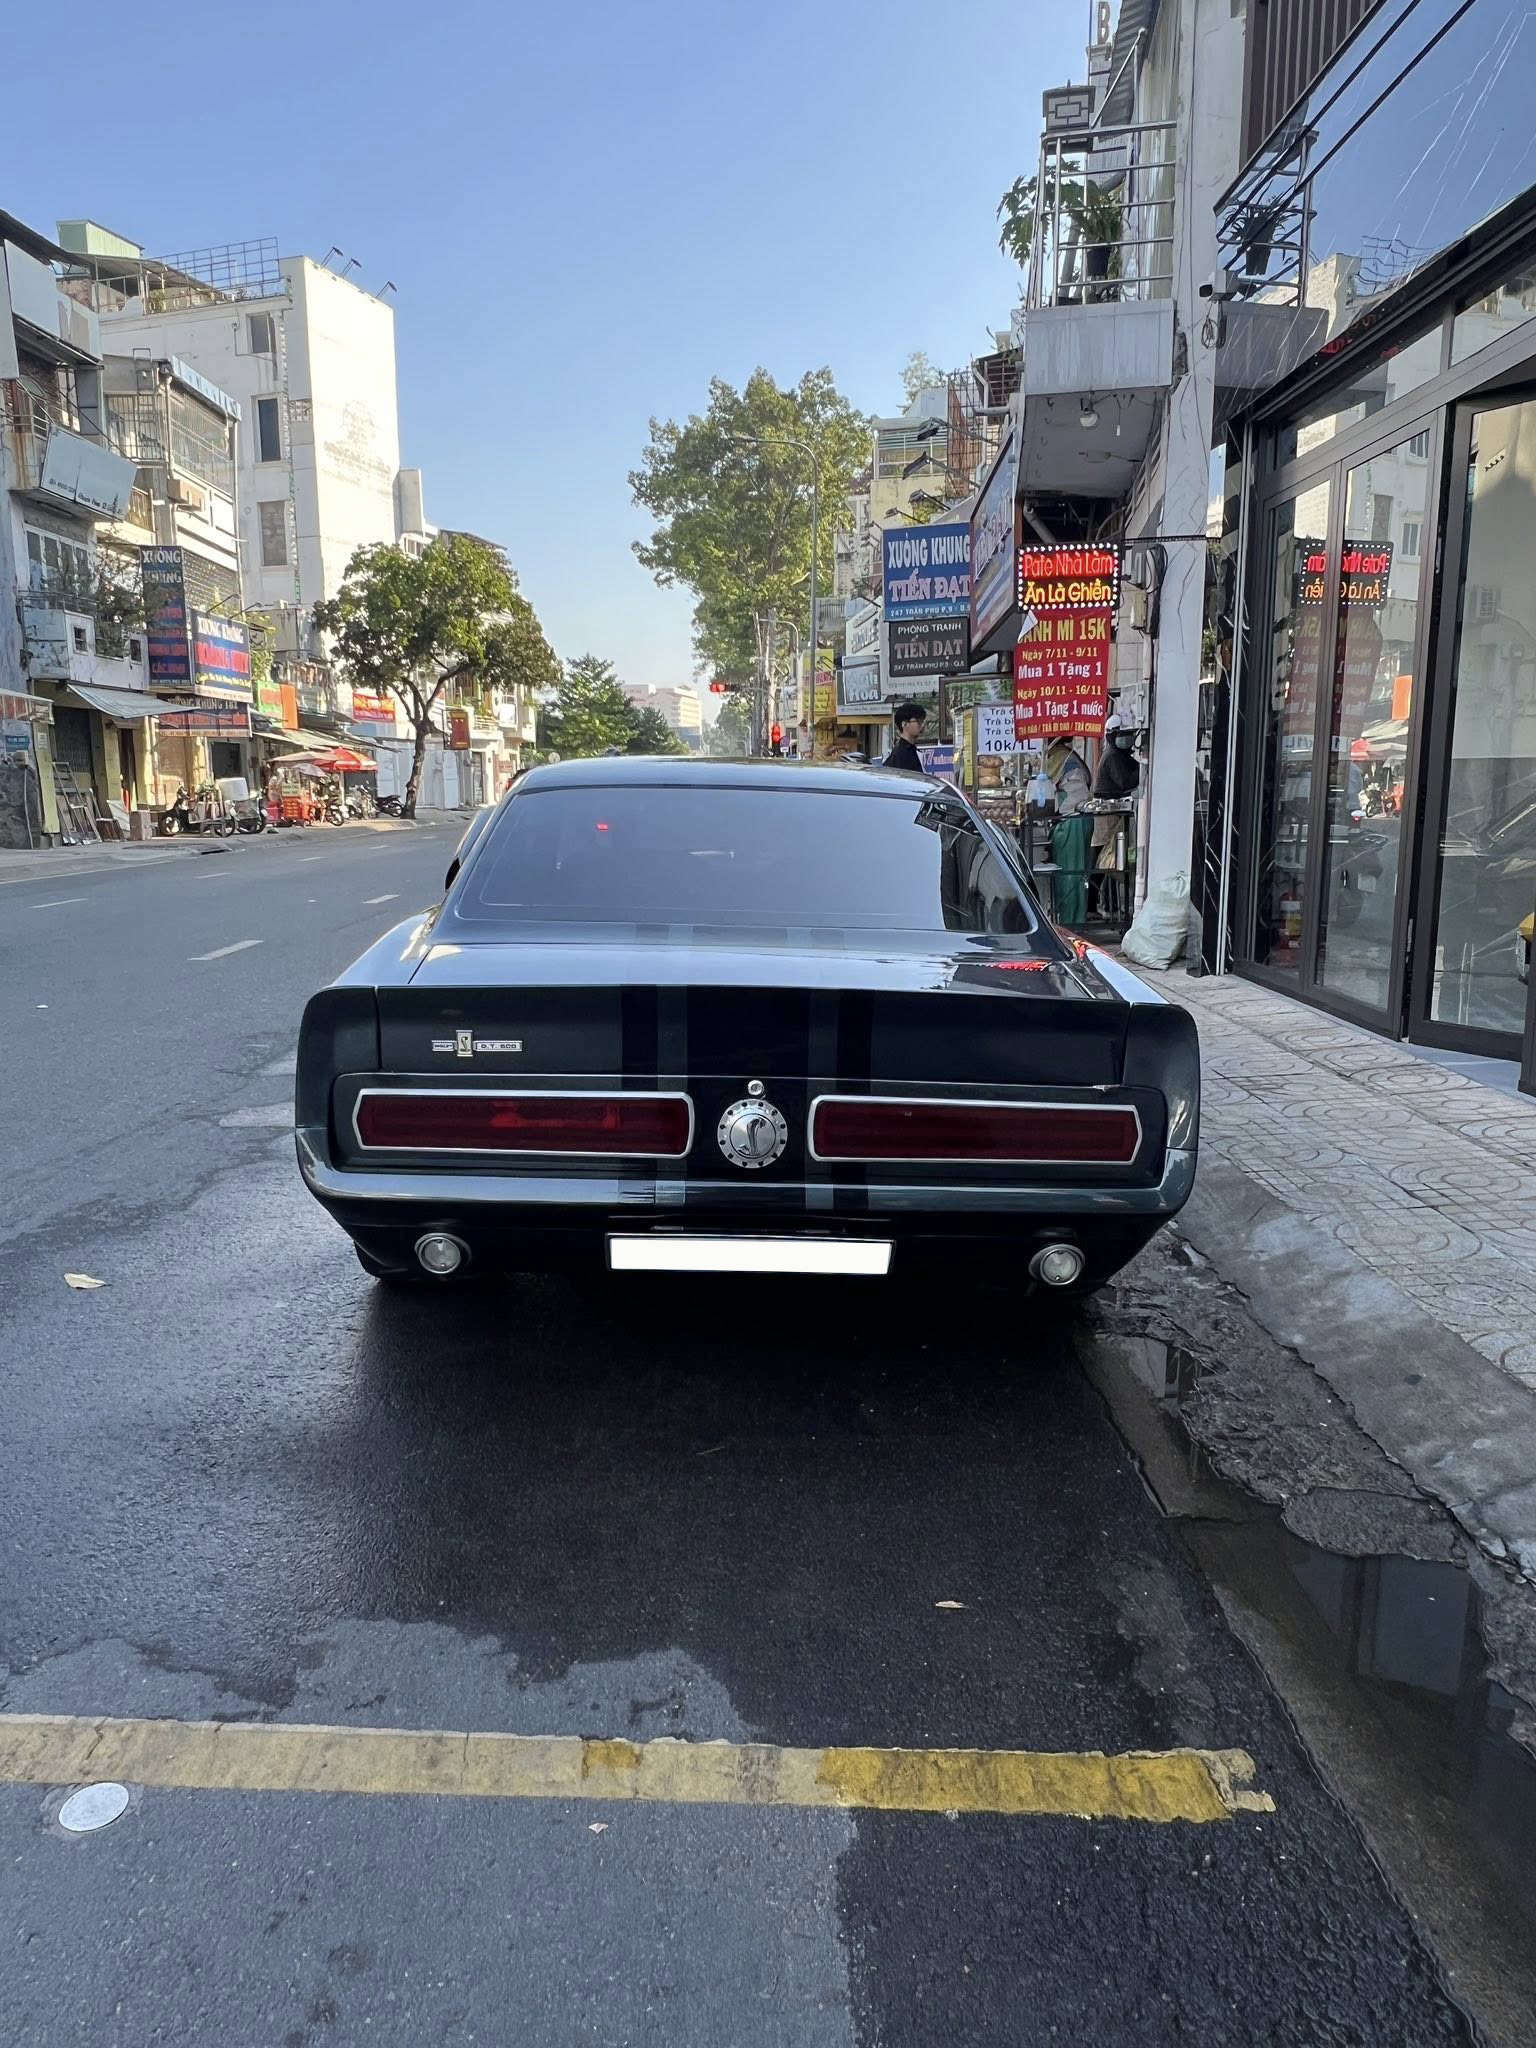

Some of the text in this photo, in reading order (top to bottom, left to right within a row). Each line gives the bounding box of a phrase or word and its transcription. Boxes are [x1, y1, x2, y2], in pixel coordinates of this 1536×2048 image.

[931, 534, 971, 565] KHUNG
[1056, 551, 1082, 576] Nhà
[1085, 549, 1113, 574] Làm
[888, 567, 971, 604] TIẾN ĐẠT
[1024, 577, 1111, 604] Ăn Là Ghiền
[931, 622, 962, 632] TRANH
[1057, 614, 1074, 641] MÌ
[1079, 617, 1106, 640] 15K
[894, 634, 929, 660] TIẾN
[1022, 650, 1043, 661] Ngày
[1045, 648, 1068, 659] 7/11
[1075, 647, 1098, 657] 9/11
[1018, 661, 1103, 680] Mua 1 Tặng 1
[1017, 688, 1038, 700] Ngày
[1040, 686, 1066, 697] 10/11
[1075, 685, 1102, 696] 16/11
[1015, 703, 1034, 719] Mua
[1036, 701, 1042, 717] 1
[1045, 700, 1069, 720] Tặng
[1072, 699, 1078, 715] 1
[1081, 701, 1104, 716] nước
